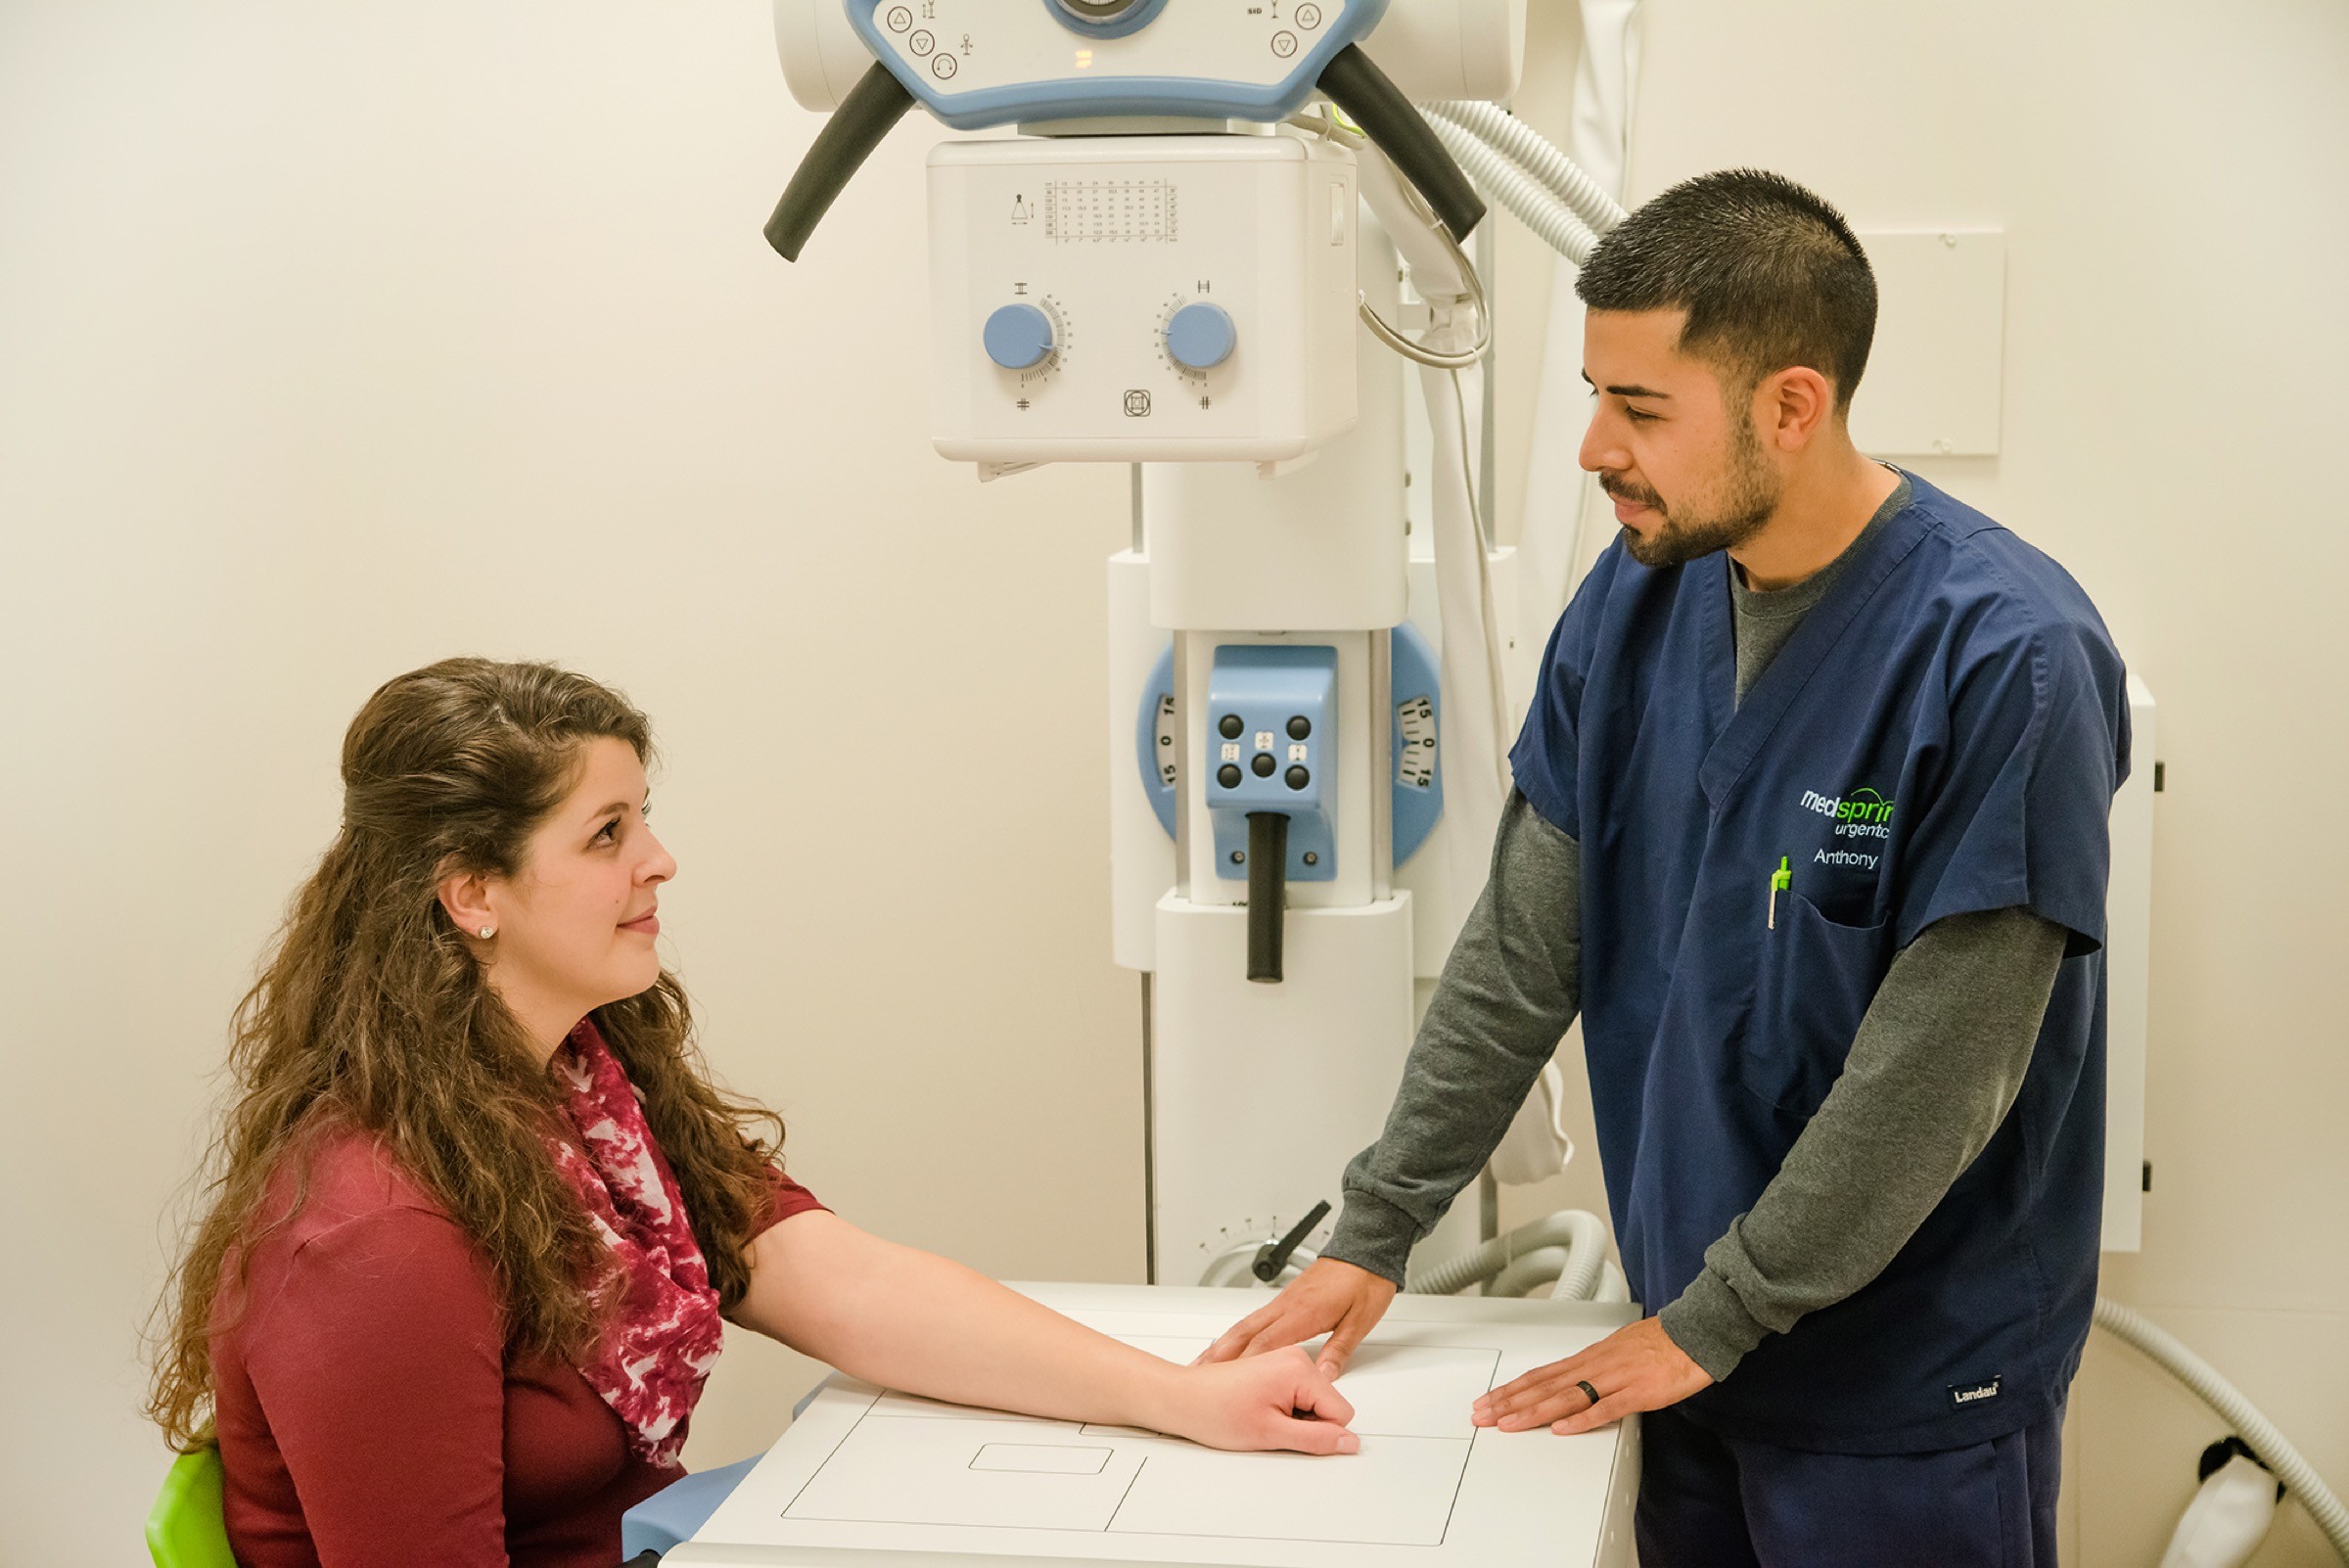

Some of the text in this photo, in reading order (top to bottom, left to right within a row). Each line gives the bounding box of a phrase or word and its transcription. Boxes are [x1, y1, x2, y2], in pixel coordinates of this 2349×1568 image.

[1417, 698, 1432, 718] 15
[1160, 735, 1172, 746] 0
[1422, 738, 1435, 748] 0
[1417, 768, 1432, 787] 15
[1814, 848, 1879, 870] Anthony
[1954, 1386, 1998, 1403] Landau
